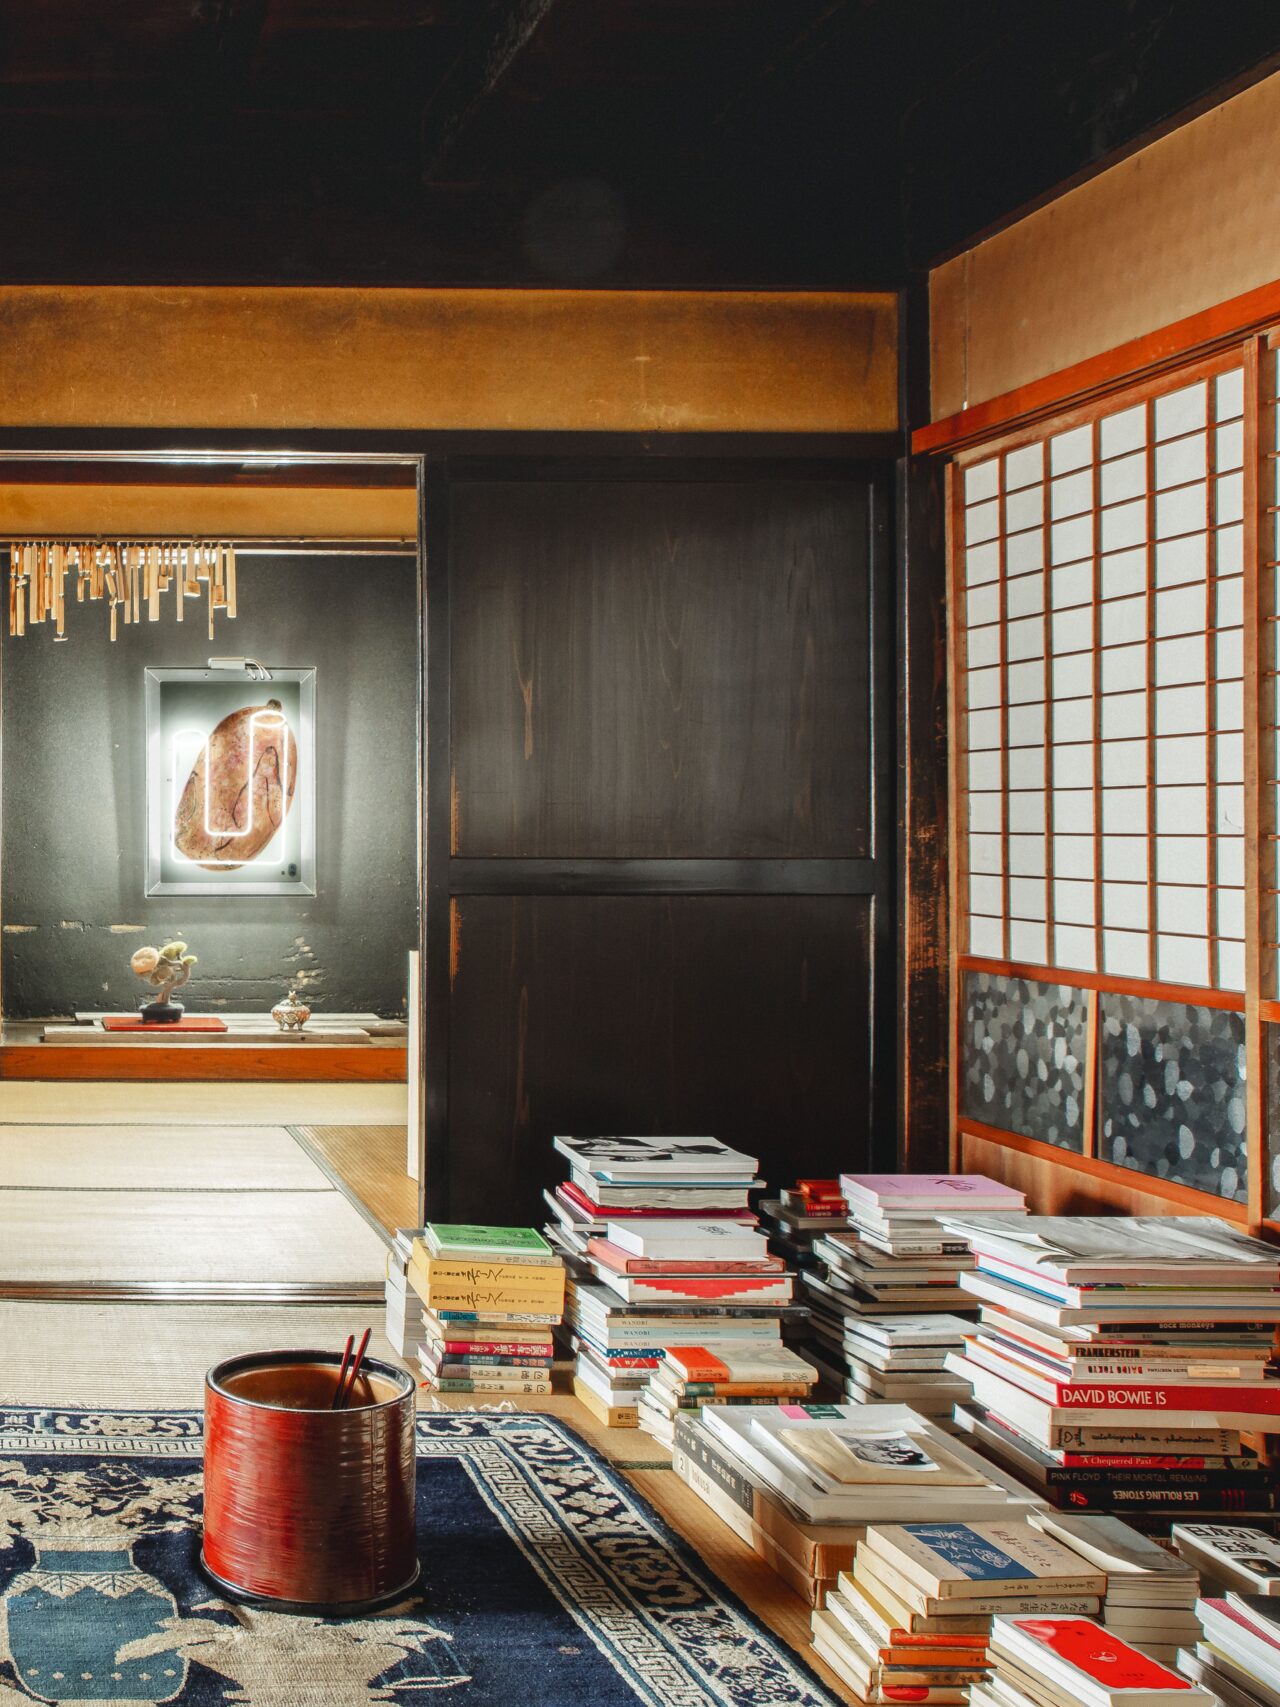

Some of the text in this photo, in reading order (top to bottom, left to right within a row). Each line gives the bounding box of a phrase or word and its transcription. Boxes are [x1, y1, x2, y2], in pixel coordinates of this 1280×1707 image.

[1179, 1322, 1215, 1330] monkeys
[1075, 1347, 1140, 1358] FRANKENSTEIN
[1088, 1365, 1143, 1374] DAIDO TOKYO
[1062, 1389, 1167, 1405] DAVID BOWIE IS
[1082, 1457, 1152, 1466] A Chequered Past
[1051, 1472, 1208, 1483] PINK FLOYD THEIR MORTAL REMAINS
[1112, 1490, 1200, 1501] LES ROLLING STONES
[1184, 1525, 1258, 1540] 日本の
